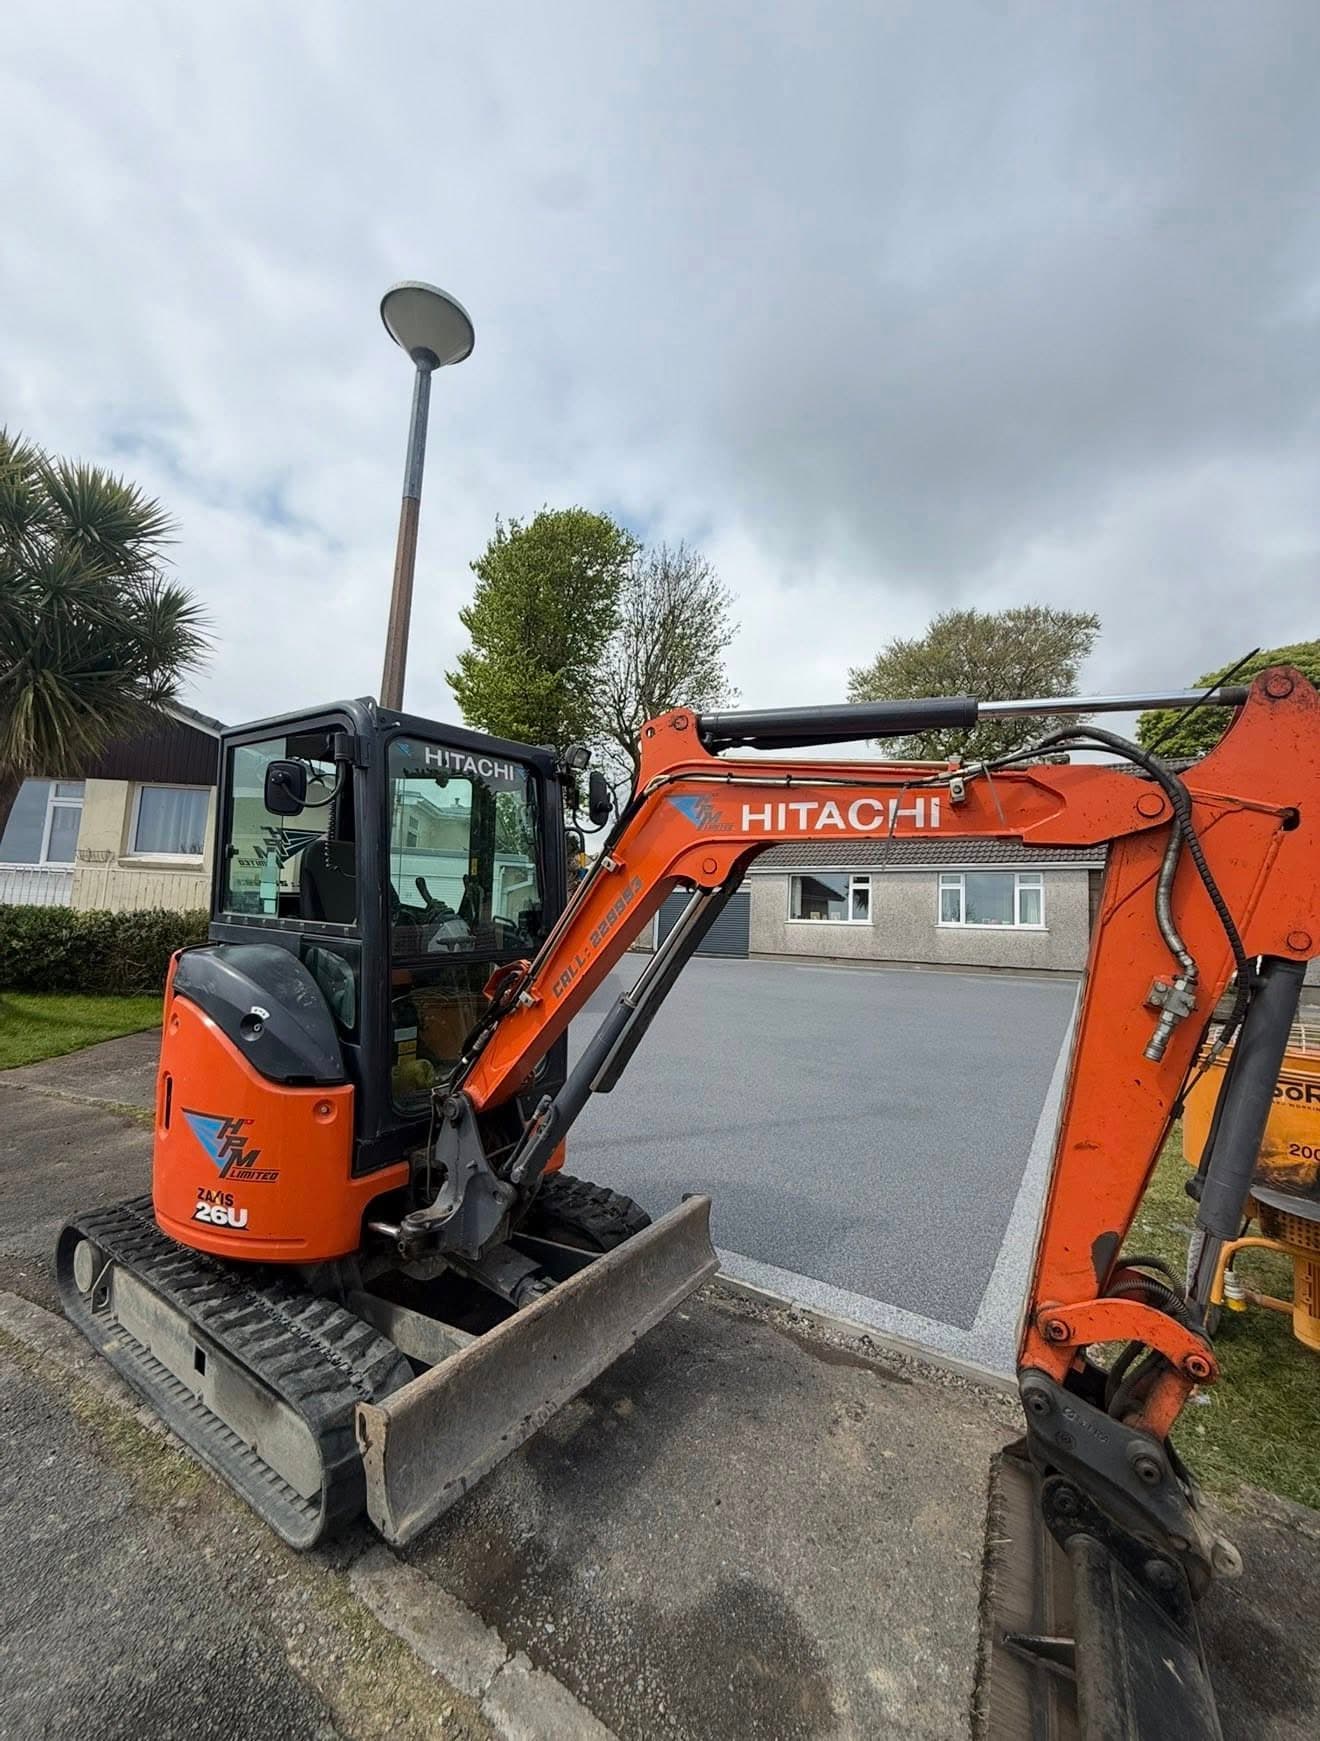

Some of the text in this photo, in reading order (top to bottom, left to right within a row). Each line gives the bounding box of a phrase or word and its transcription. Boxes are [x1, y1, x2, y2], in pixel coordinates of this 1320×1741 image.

[424, 746, 515, 781] HITACHI
[741, 797, 940, 833] HITACHI
[229, 1170, 280, 1181] LIMITED
[194, 1201, 249, 1229] 26U
